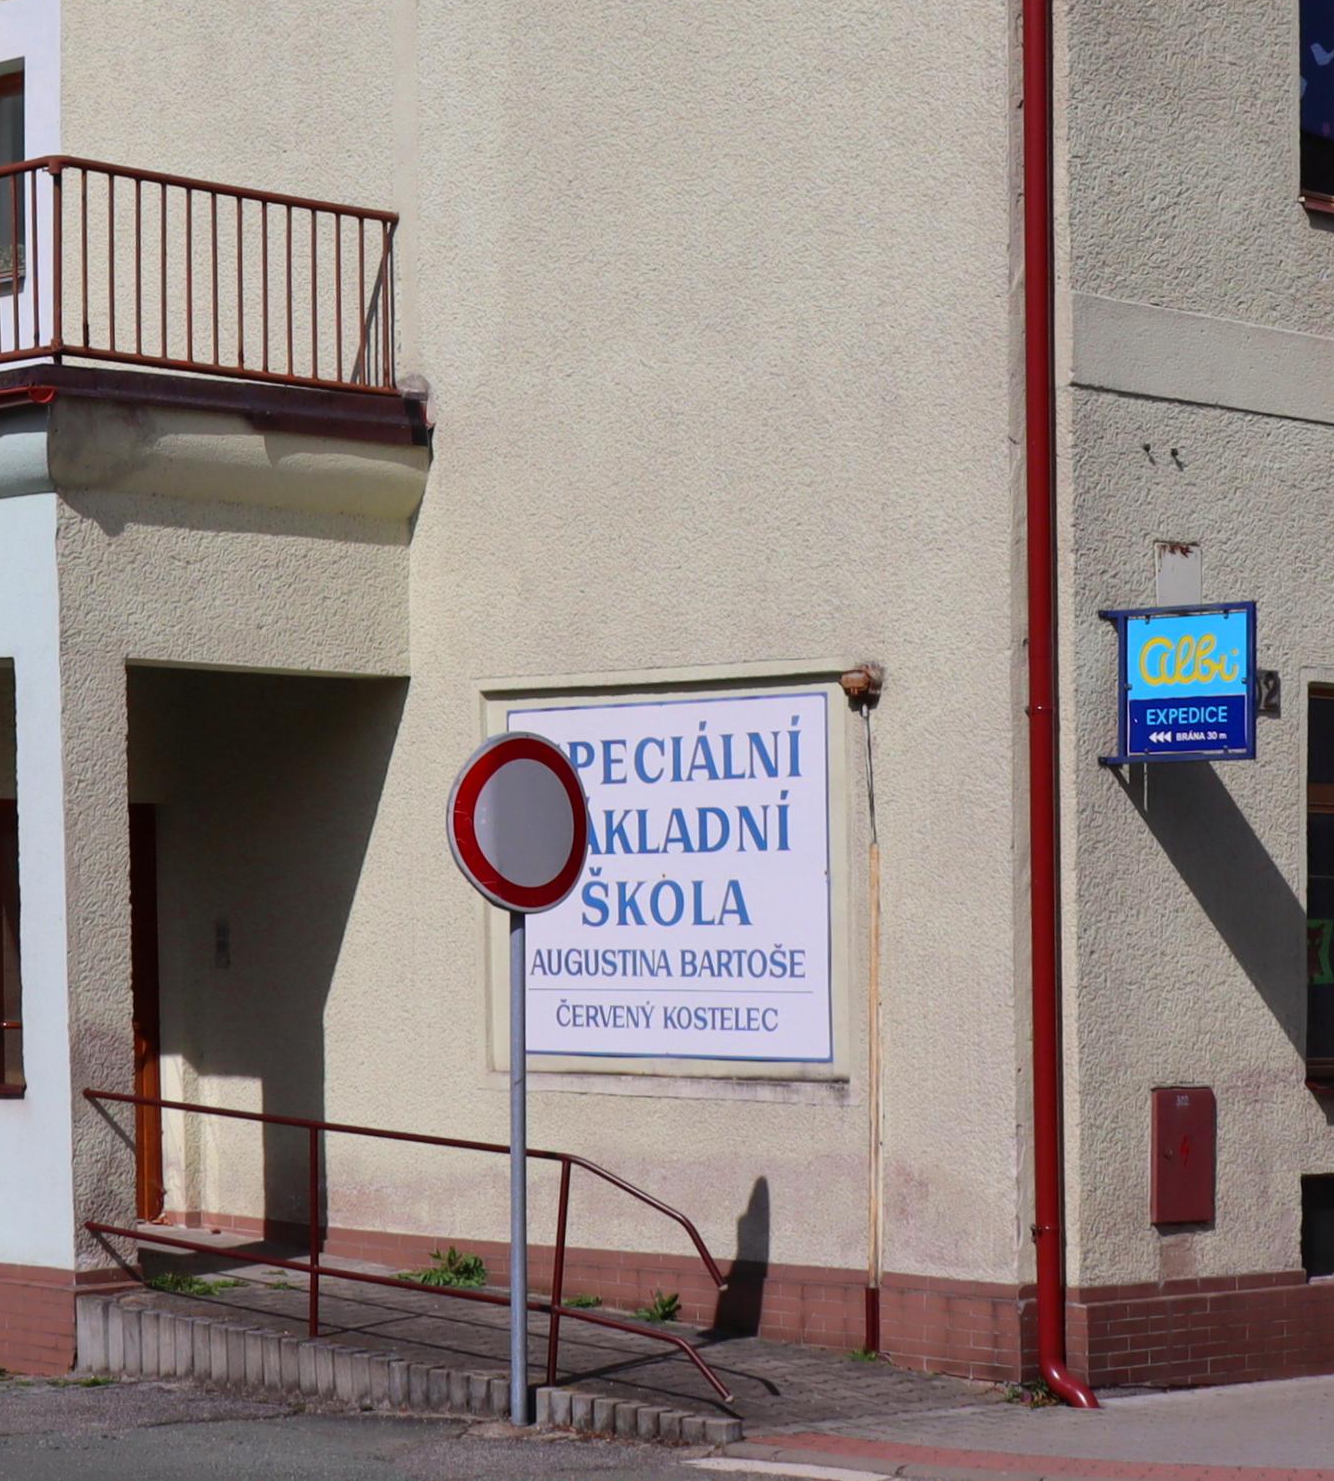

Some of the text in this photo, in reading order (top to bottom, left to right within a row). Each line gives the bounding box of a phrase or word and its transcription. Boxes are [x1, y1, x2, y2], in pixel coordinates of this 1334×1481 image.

[1146, 706, 1228, 725] EXPEDICE
[564, 715, 802, 785] PECIÁLNÍ
[1175, 730, 1227, 741] BRÁNA 30 m
[585, 790, 791, 855] ÁKLADNÍ
[581, 867, 753, 928] ŠKOLA
[530, 943, 807, 979] AUGUSTINA BARTOŠE
[555, 999, 780, 1033] ČERVENÝ KOSTELEC
